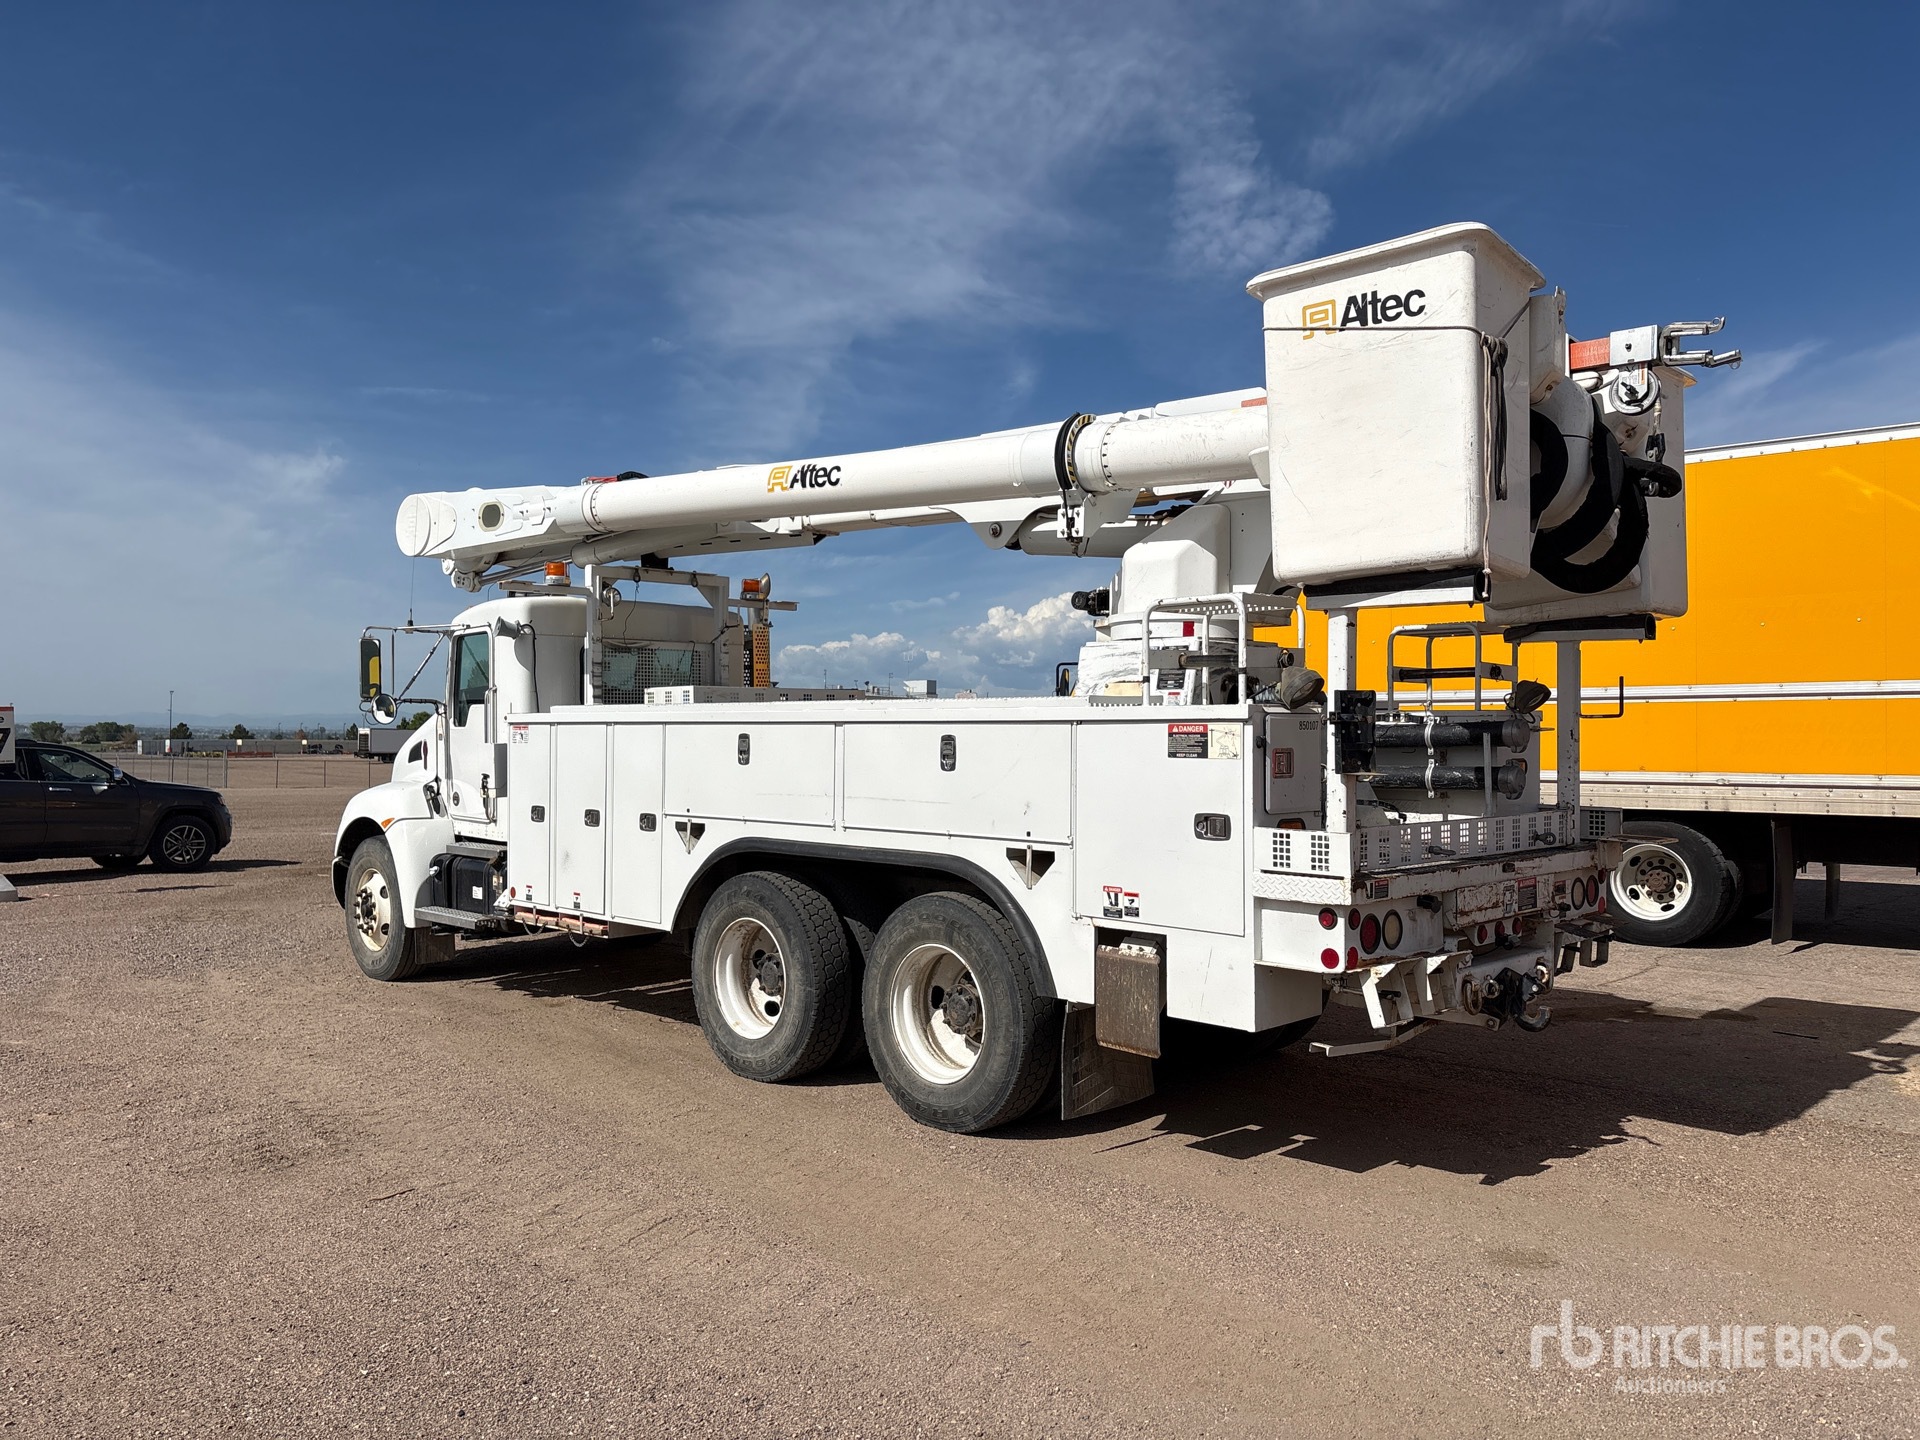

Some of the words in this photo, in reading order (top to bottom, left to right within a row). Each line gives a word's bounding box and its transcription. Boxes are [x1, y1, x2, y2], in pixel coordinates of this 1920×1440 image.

[1339, 288, 1426, 332] Altec
[789, 464, 842, 489] Altec
[1299, 720, 1319, 731] 850107
